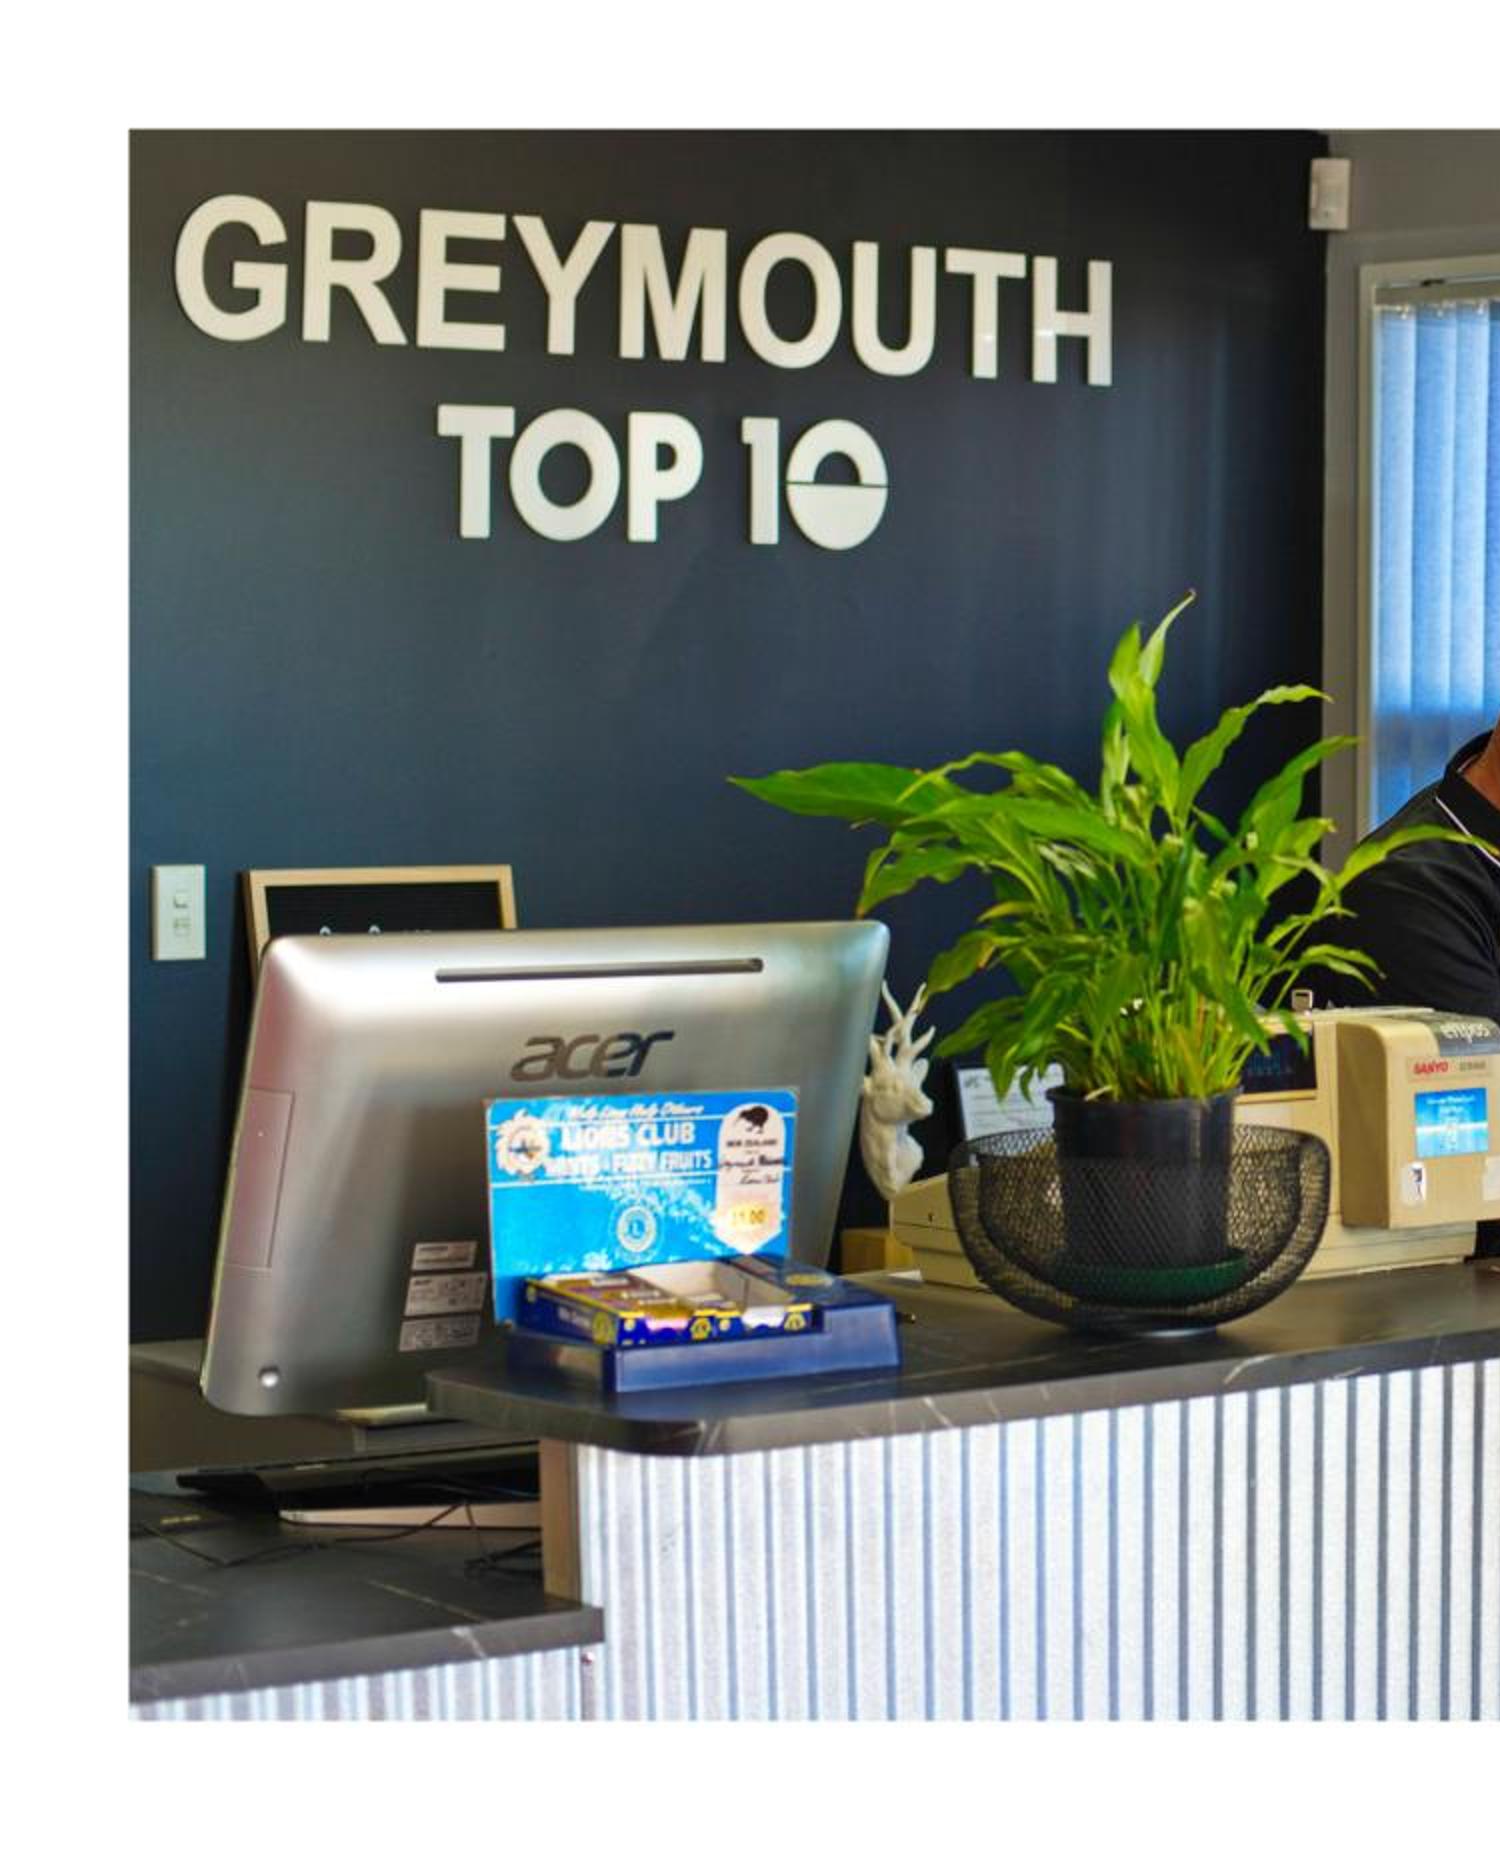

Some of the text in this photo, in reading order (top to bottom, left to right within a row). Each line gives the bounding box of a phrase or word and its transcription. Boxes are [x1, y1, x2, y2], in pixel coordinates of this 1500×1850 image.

[173, 193, 1113, 387] GREYMOUTH
[437, 404, 889, 551] TOP 10
[511, 1030, 675, 1082] acer
[1414, 1060, 1448, 1075] SANYO
[560, 1122, 695, 1151] LIONS CLUB
[660, 1150, 713, 1170] FRUITS
